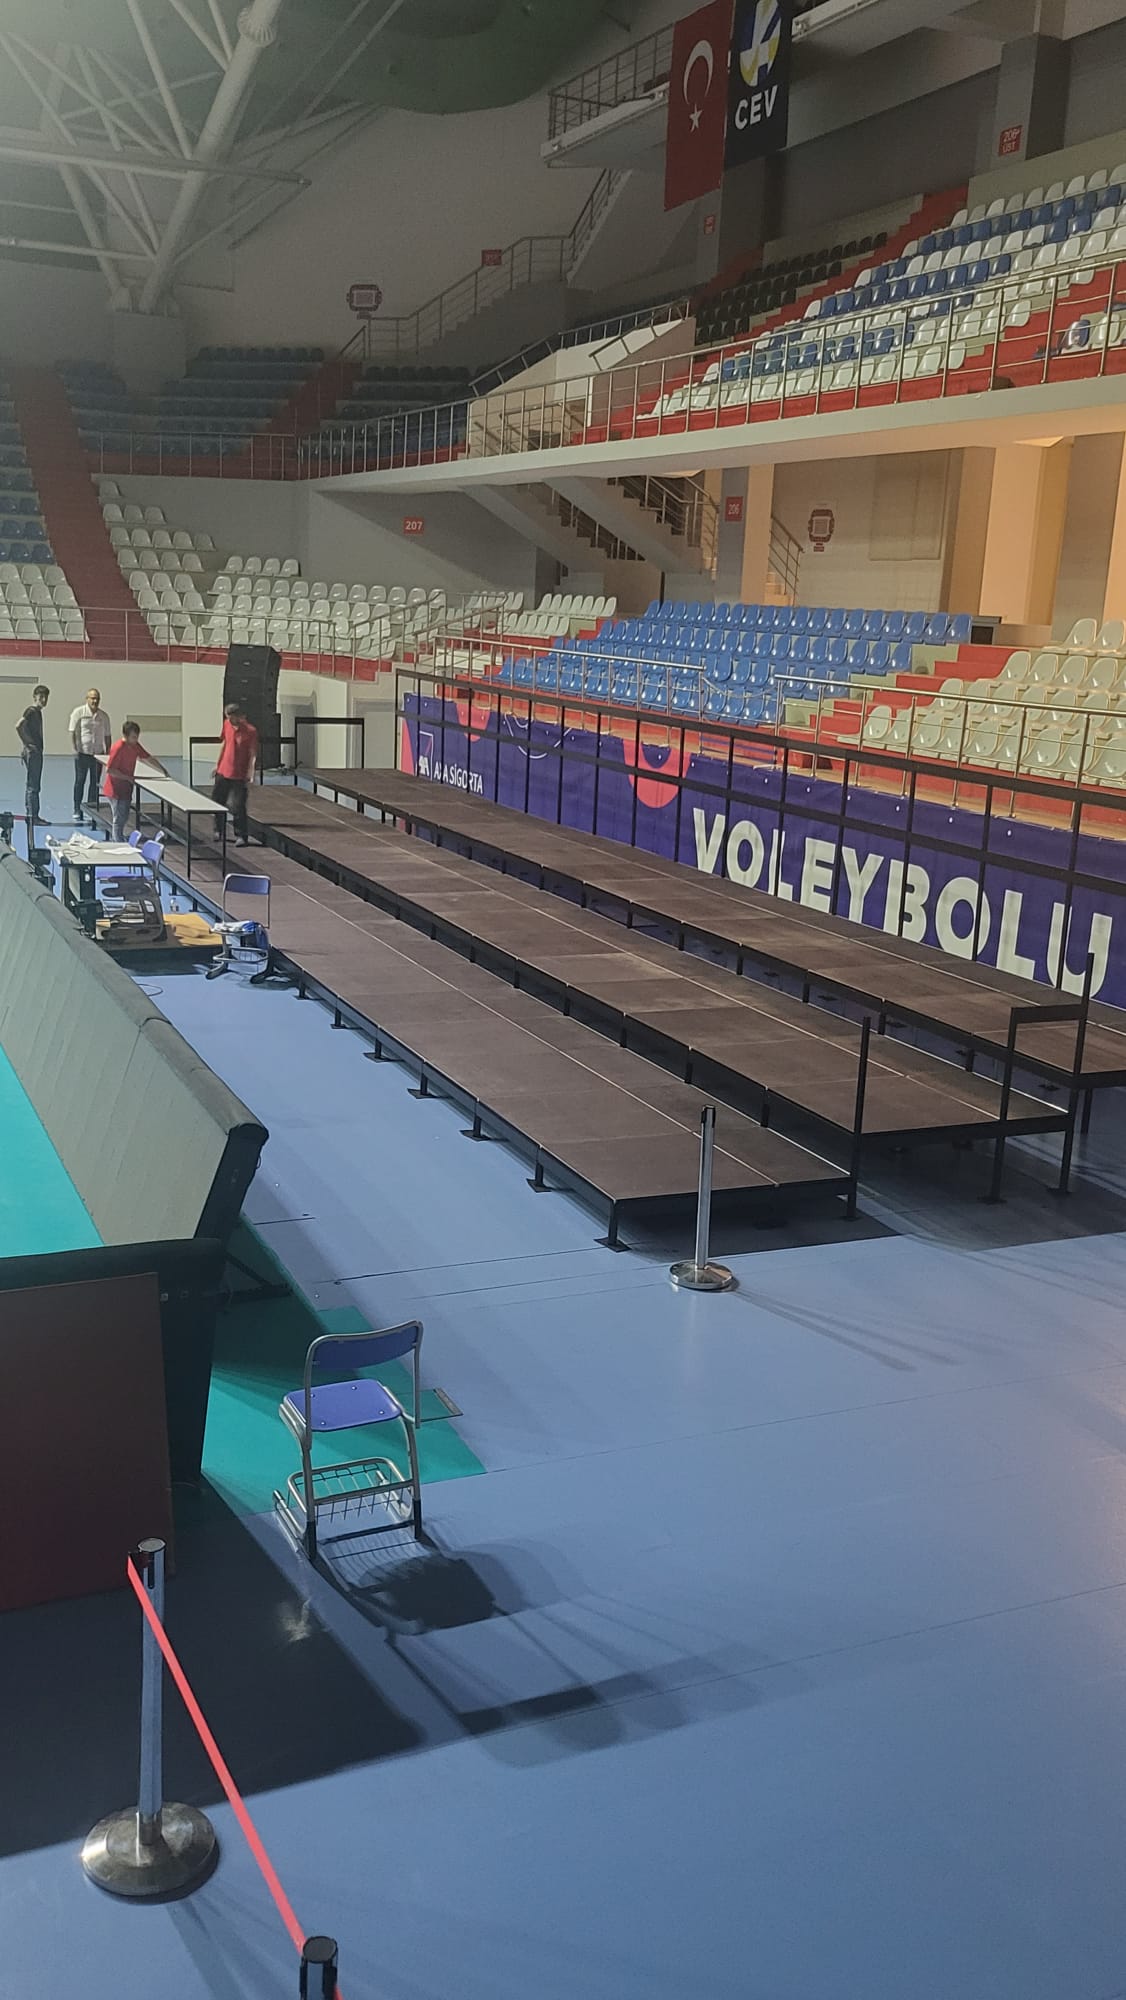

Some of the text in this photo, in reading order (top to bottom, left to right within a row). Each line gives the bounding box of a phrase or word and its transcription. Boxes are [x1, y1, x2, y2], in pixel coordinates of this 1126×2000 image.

[735, 84, 778, 130] CEV
[405, 520, 423, 531] 207
[693, 807, 1113, 998] VOLEYBOLU
